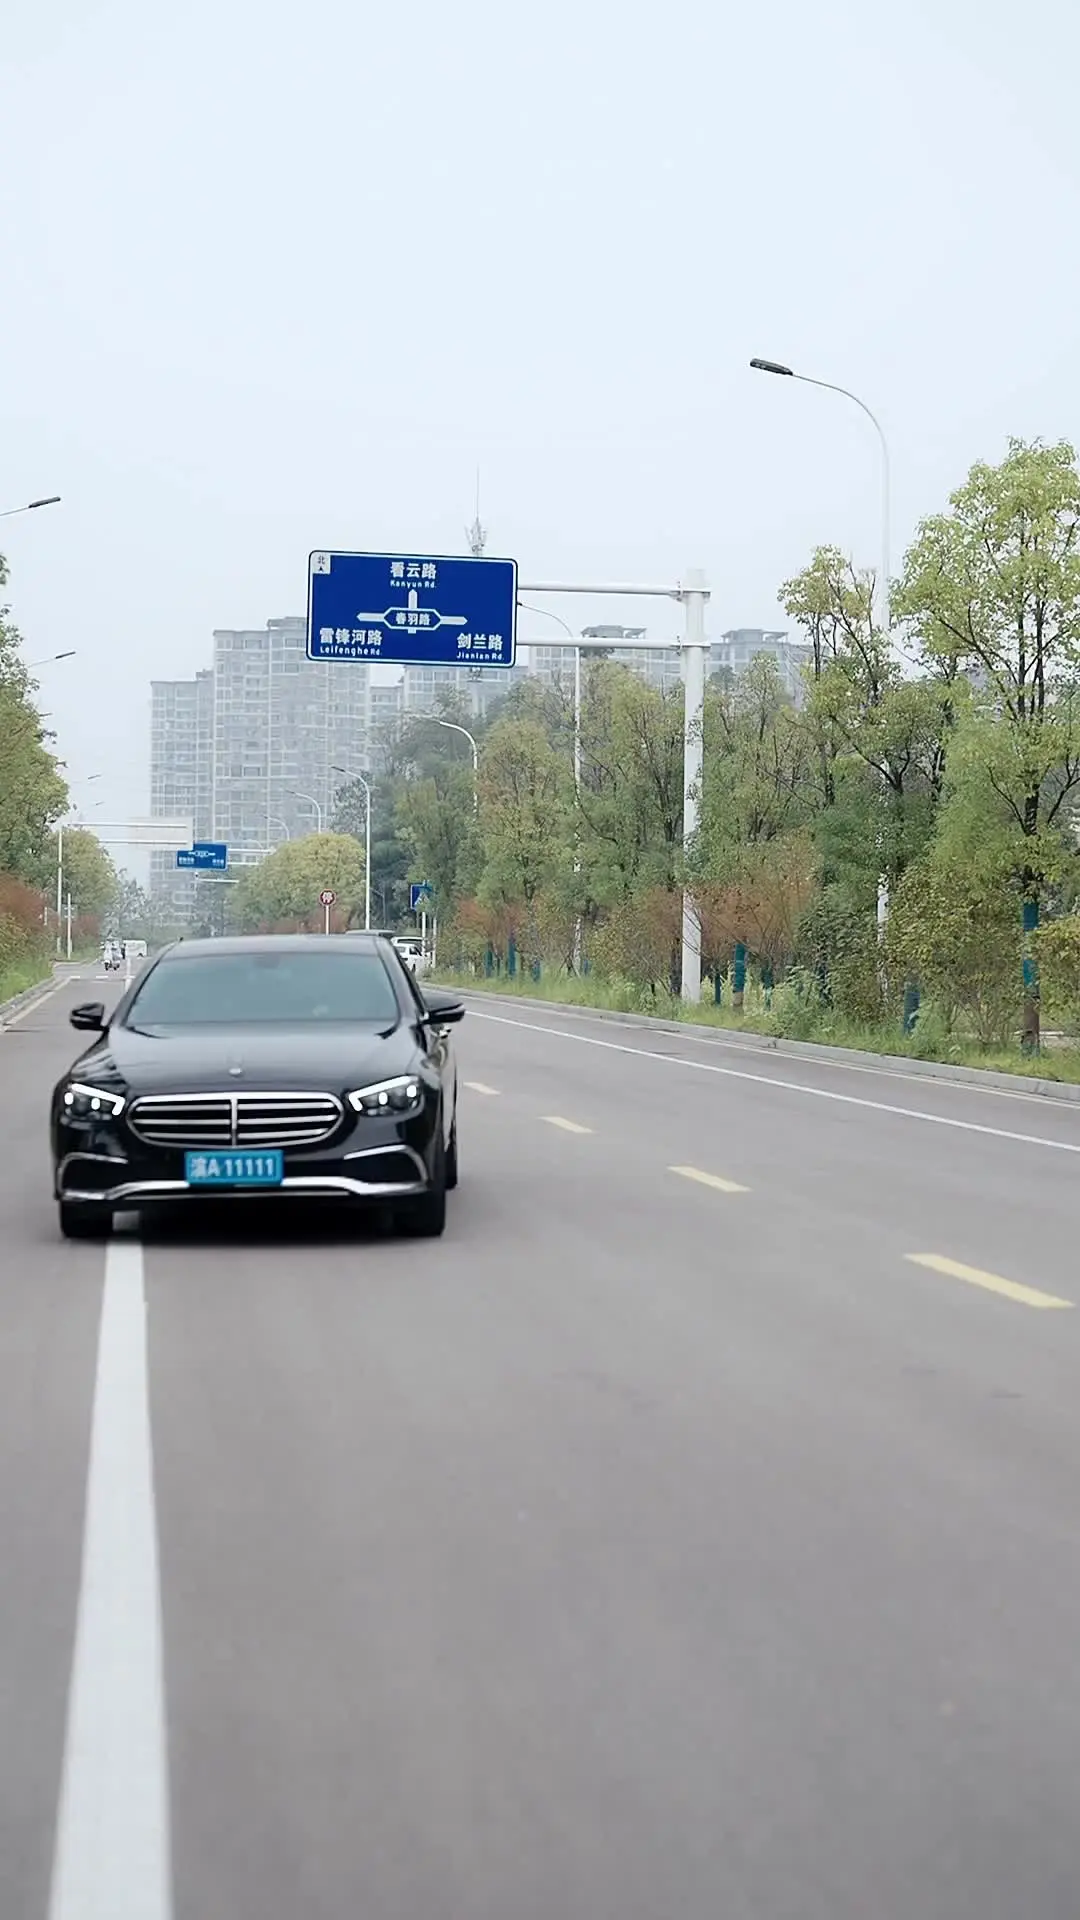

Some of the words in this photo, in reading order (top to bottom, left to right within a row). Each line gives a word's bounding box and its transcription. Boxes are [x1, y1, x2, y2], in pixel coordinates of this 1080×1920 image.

[317, 554, 326, 565] 北
[390, 561, 437, 579] 看云路
[390, 580, 422, 589] Kanyun
[320, 627, 383, 646] 雷锋河路
[456, 632, 503, 651] 剑兰路
[320, 645, 369, 657] Leifenghe
[456, 651, 490, 660] Jianlan
